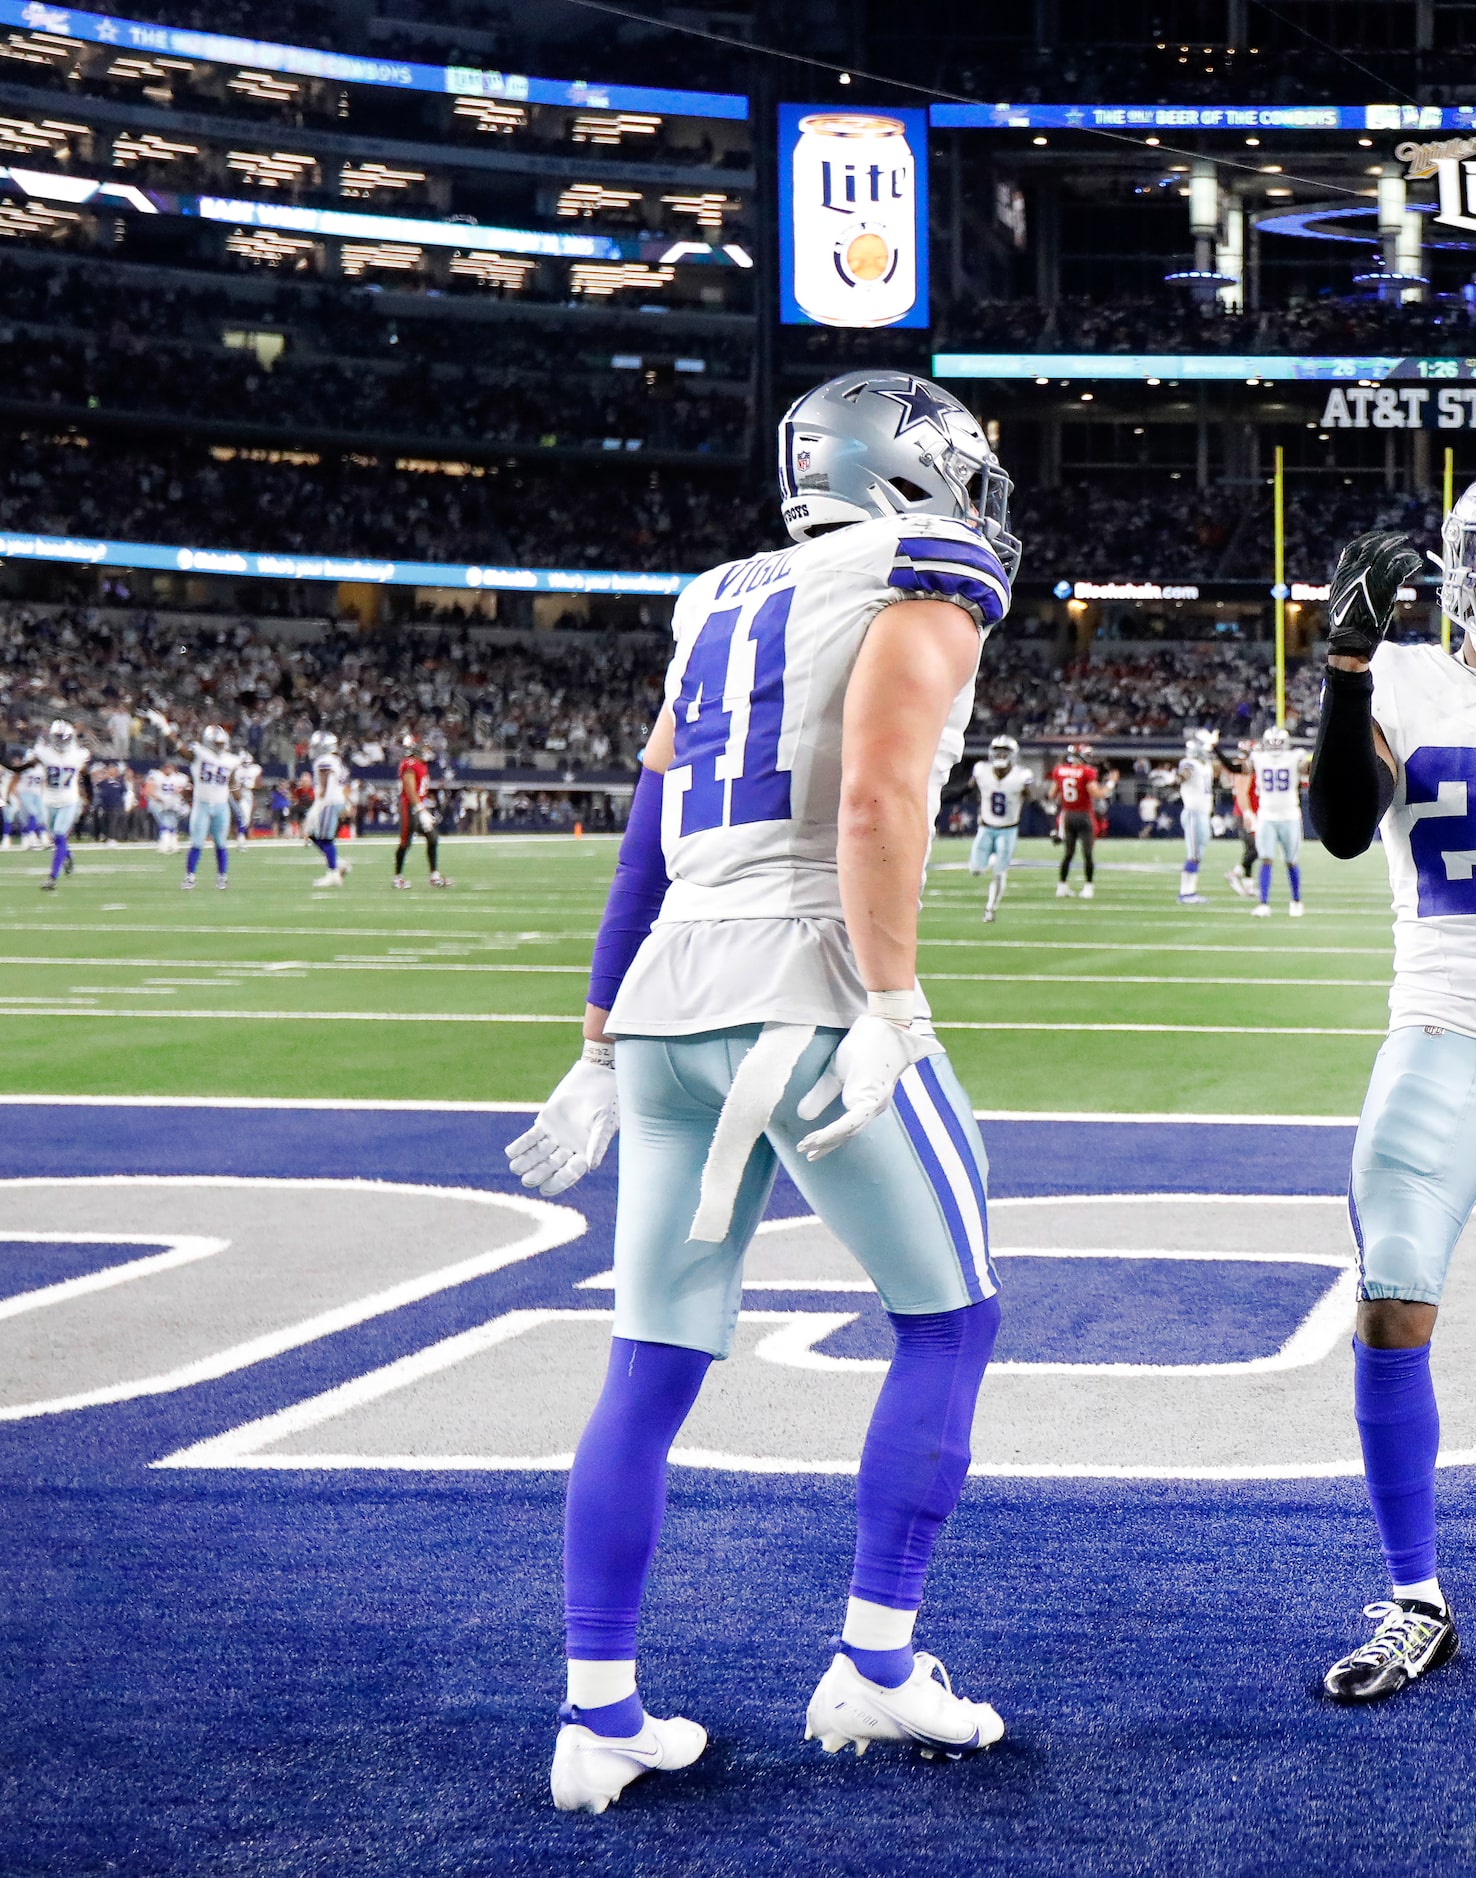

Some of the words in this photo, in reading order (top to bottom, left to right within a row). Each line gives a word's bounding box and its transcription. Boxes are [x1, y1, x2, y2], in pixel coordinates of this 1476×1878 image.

[1093, 110, 1126, 125] THE
[1156, 110, 1199, 125] BEER
[1201, 110, 1223, 125] OF
[1225, 111, 1258, 126] THE
[1259, 110, 1337, 126] COWBOYS
[821, 160, 907, 215] Lite
[1416, 360, 1459, 379] 1:26
[1320, 387, 1430, 428] AT&T
[714, 545, 803, 601] VIGIL
[666, 585, 797, 839] 41
[46, 766, 76, 789] 27
[1263, 768, 1290, 792] 99
[1062, 778, 1078, 802] 6
